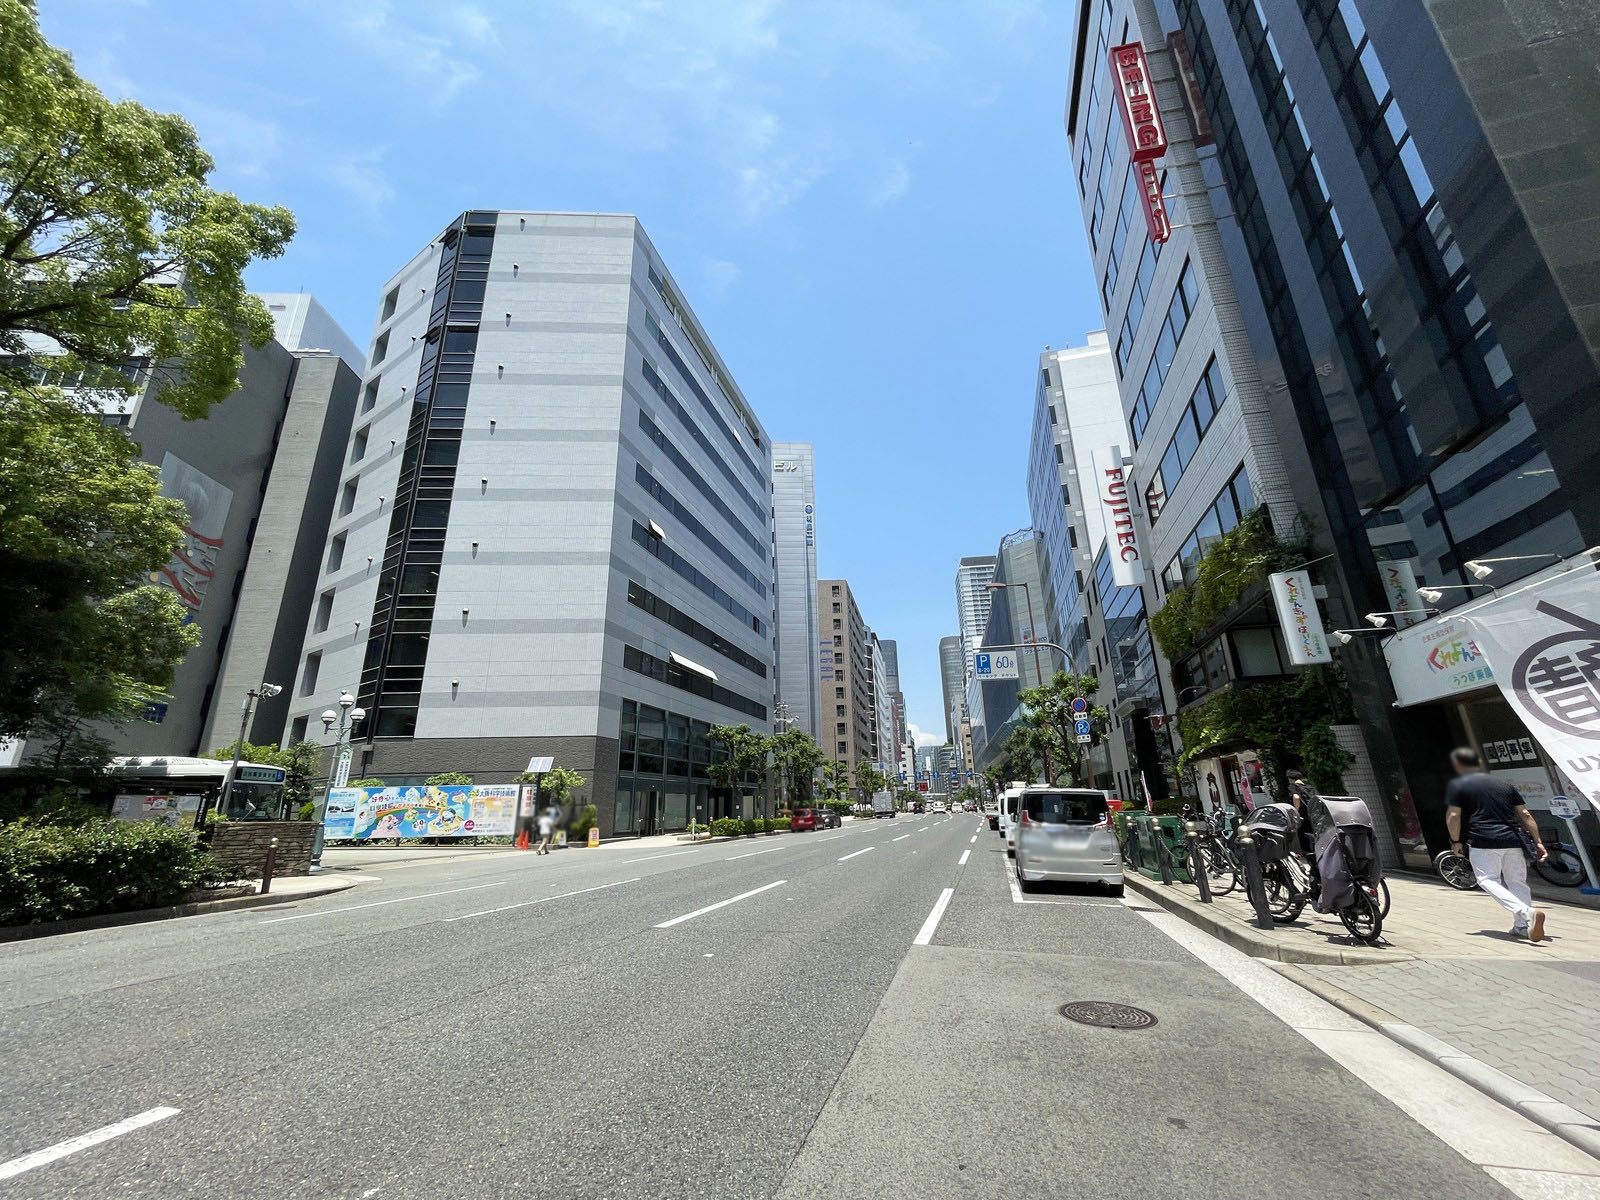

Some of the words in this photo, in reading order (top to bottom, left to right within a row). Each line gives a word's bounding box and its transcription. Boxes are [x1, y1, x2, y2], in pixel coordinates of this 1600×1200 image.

[774, 460, 797, 472] ビル
[1103, 467, 1139, 563] FUJITEC
[980, 655, 988, 667] P
